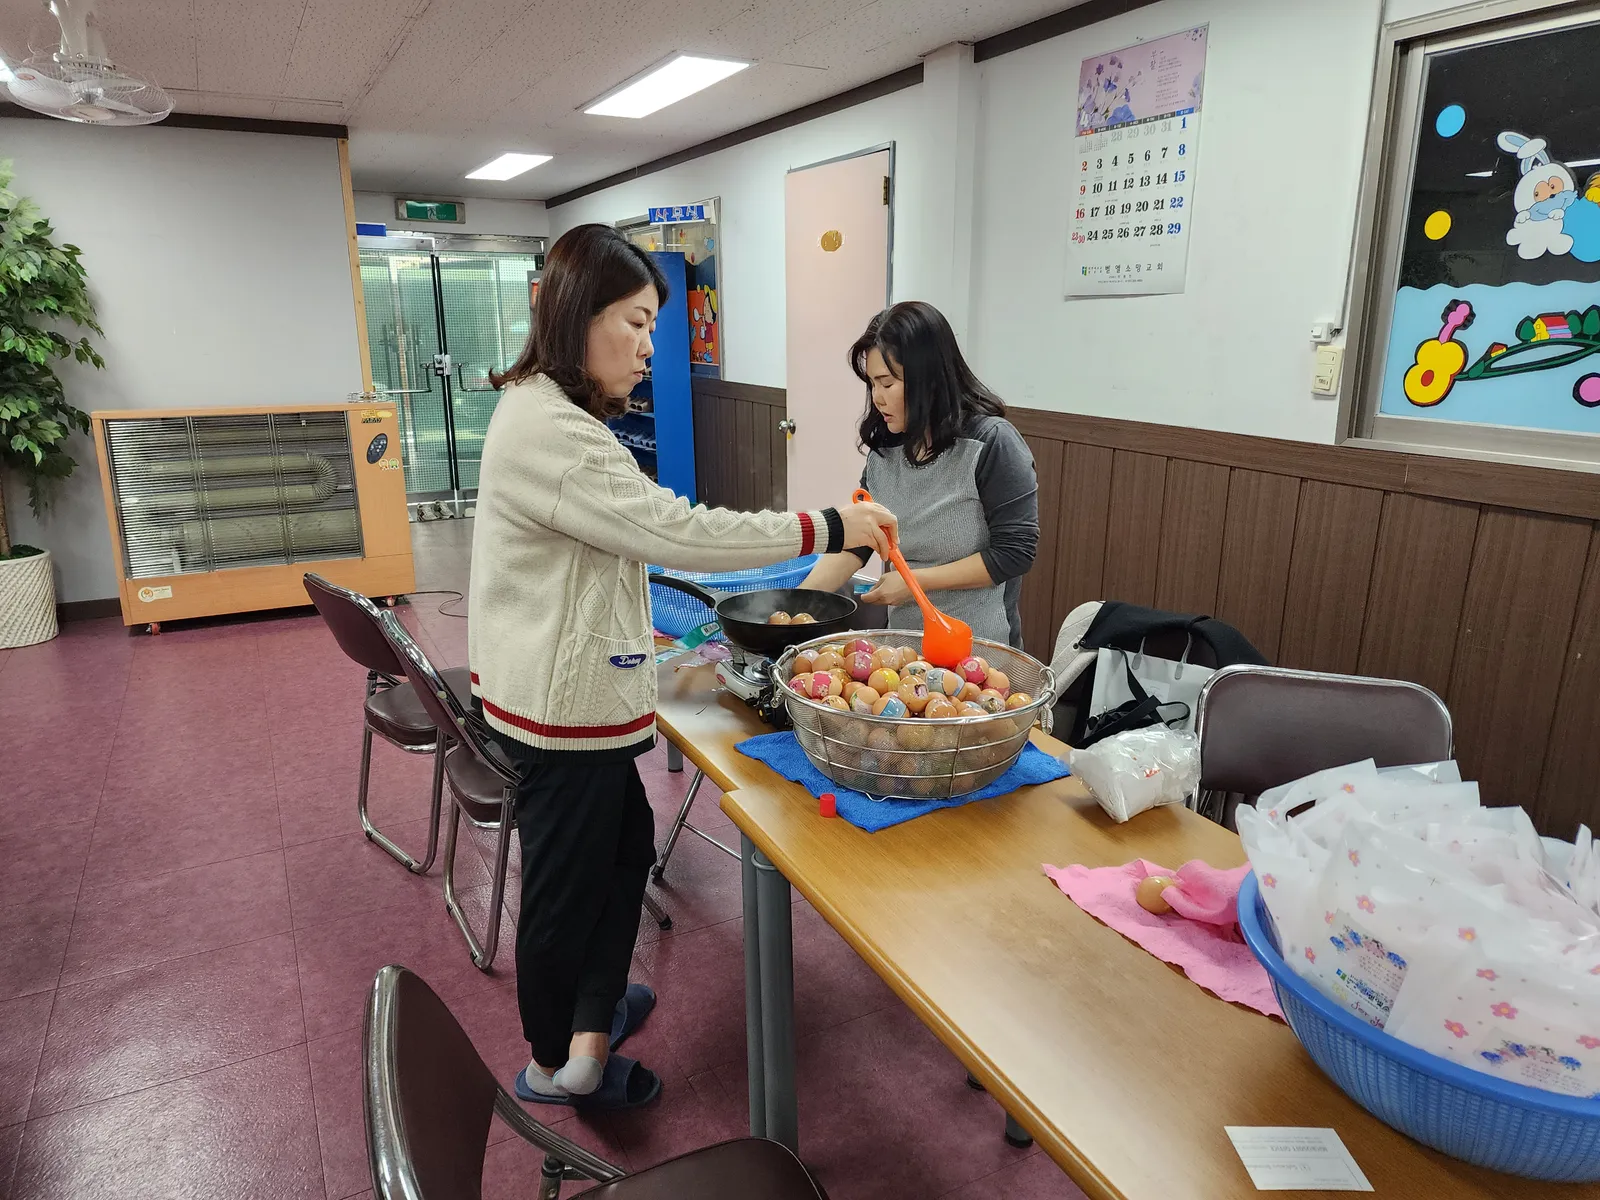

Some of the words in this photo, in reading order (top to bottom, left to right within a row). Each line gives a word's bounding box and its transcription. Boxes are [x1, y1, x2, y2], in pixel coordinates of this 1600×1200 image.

[1111, 131, 1122, 142] 28
[1127, 128, 1139, 139] 29
[1144, 124, 1155, 136] 30
[1161, 121, 1172, 132] 31
[1181, 117, 1187, 128] 1
[1081, 161, 1088, 171] 2
[1096, 159, 1103, 169] 3
[1111, 156, 1118, 166] 4
[1127, 153, 1135, 164] 5
[1144, 150, 1151, 161] 6
[1161, 147, 1168, 158] 7
[1178, 144, 1186, 155] 8
[1079, 185, 1086, 195] 9
[1092, 183, 1103, 194] 10
[1107, 181, 1118, 191] 11
[1122, 178, 1135, 189] 12
[1139, 176, 1151, 187] 13
[1155, 173, 1168, 185] 14
[1173, 170, 1186, 182] 15
[655, 205, 700, 222] 사무실
[1075, 208, 1085, 219] 16
[1090, 207, 1101, 217] 17
[1104, 205, 1116, 215] 18
[1120, 203, 1132, 214] 19
[1135, 201, 1149, 212] 20
[1152, 199, 1165, 210] 21
[1169, 197, 1184, 208] 22
[1071, 232, 1079, 241] 23
[1078, 235, 1085, 243] 30
[1087, 231, 1099, 241] 24
[1101, 229, 1114, 239] 25
[1116, 227, 1130, 238] 26
[1133, 226, 1147, 237] 27
[1149, 224, 1164, 235] 28
[1166, 223, 1182, 234] 29
